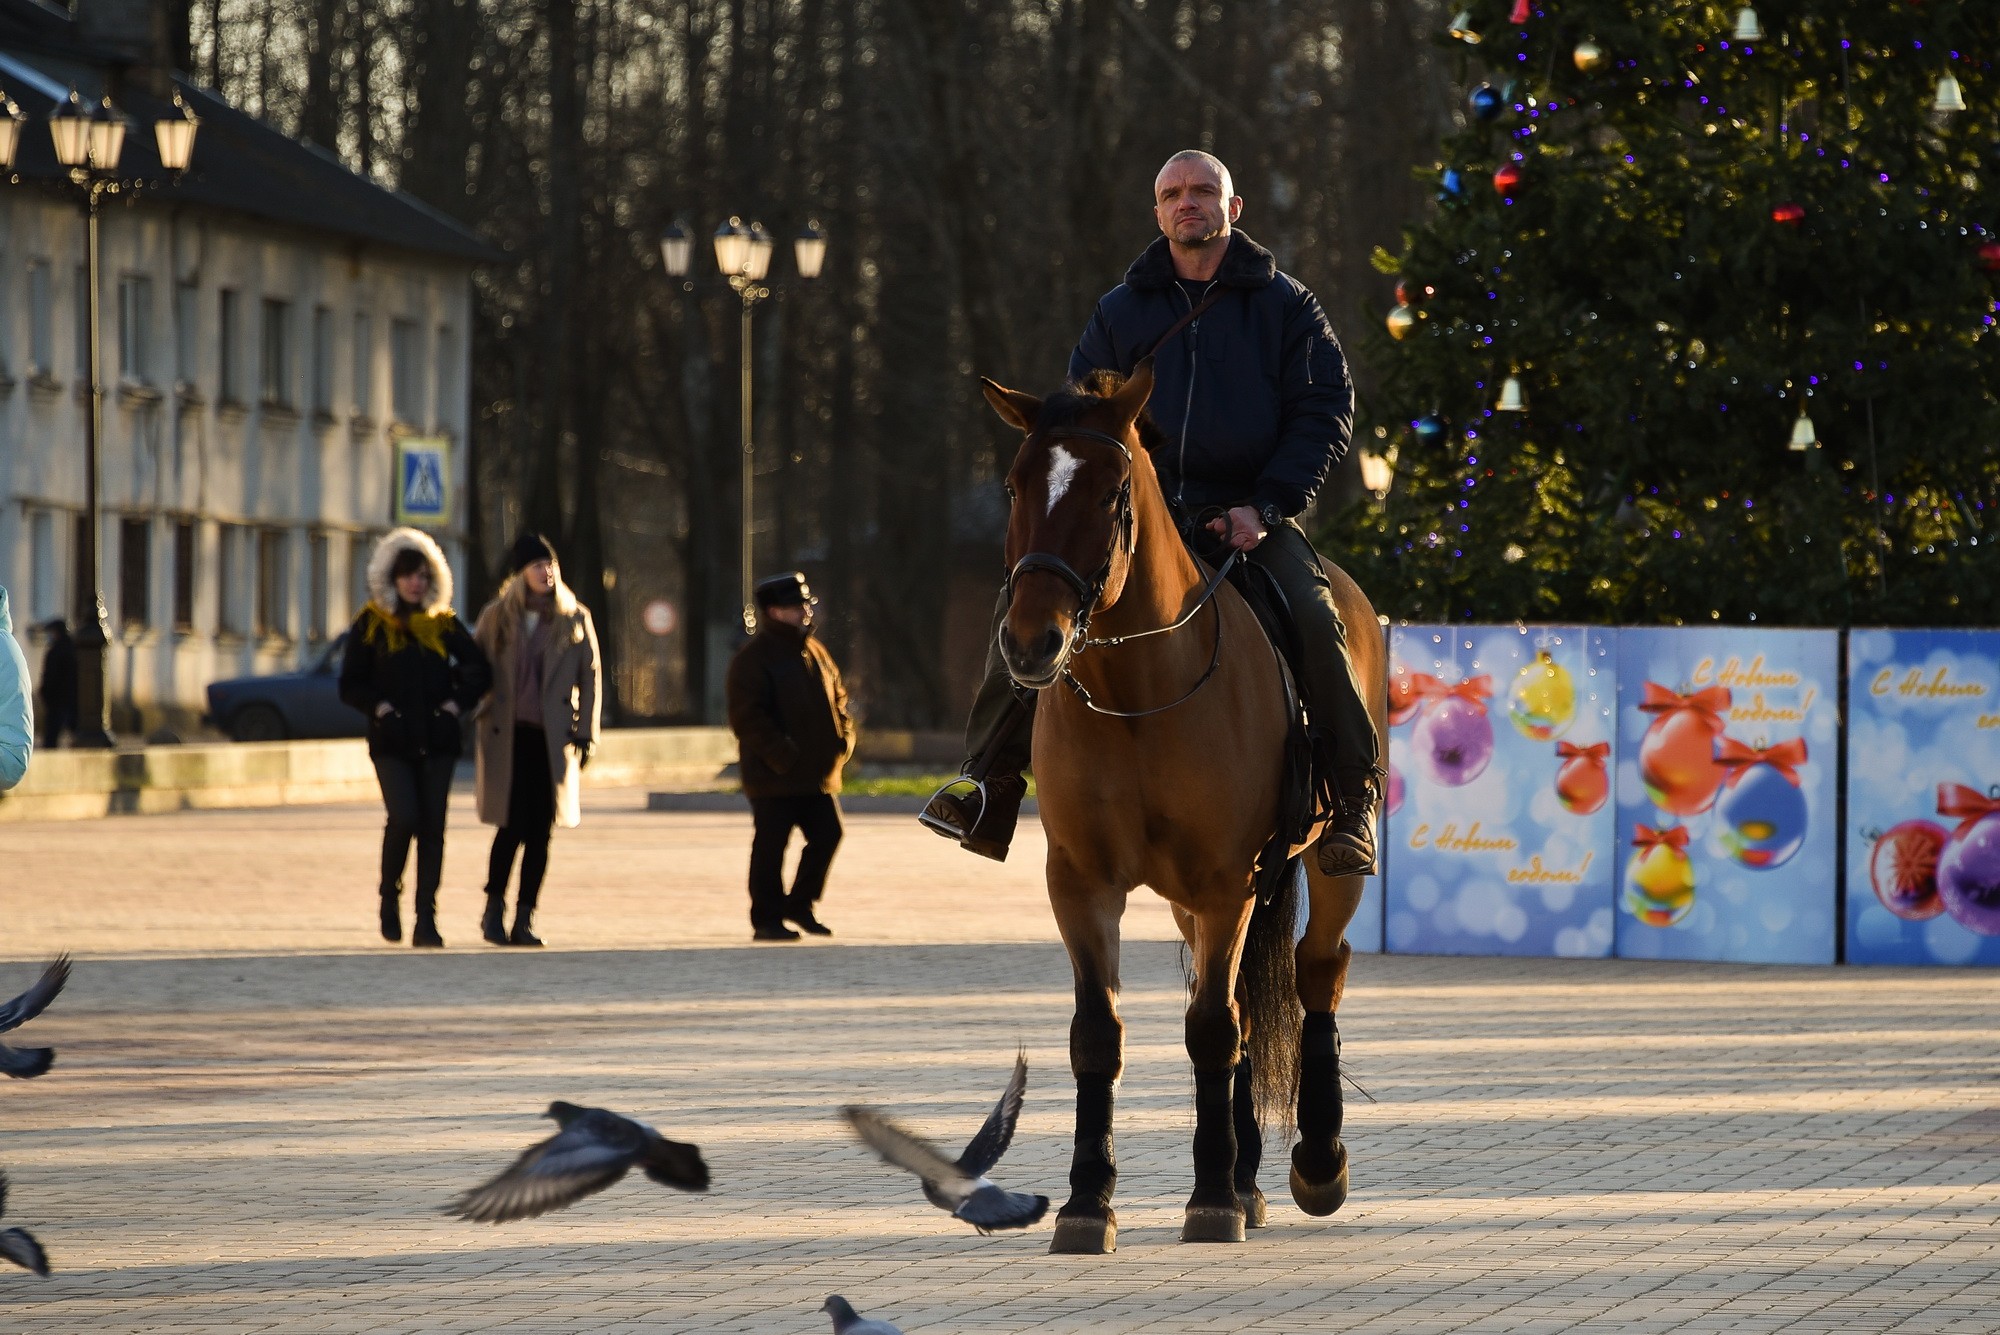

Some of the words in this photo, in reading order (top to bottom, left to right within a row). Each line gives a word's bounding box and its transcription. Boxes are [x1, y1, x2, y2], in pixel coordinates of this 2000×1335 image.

[1693, 658, 1712, 684] С
[1871, 669, 1891, 696] С
[1410, 823, 1429, 848] С
